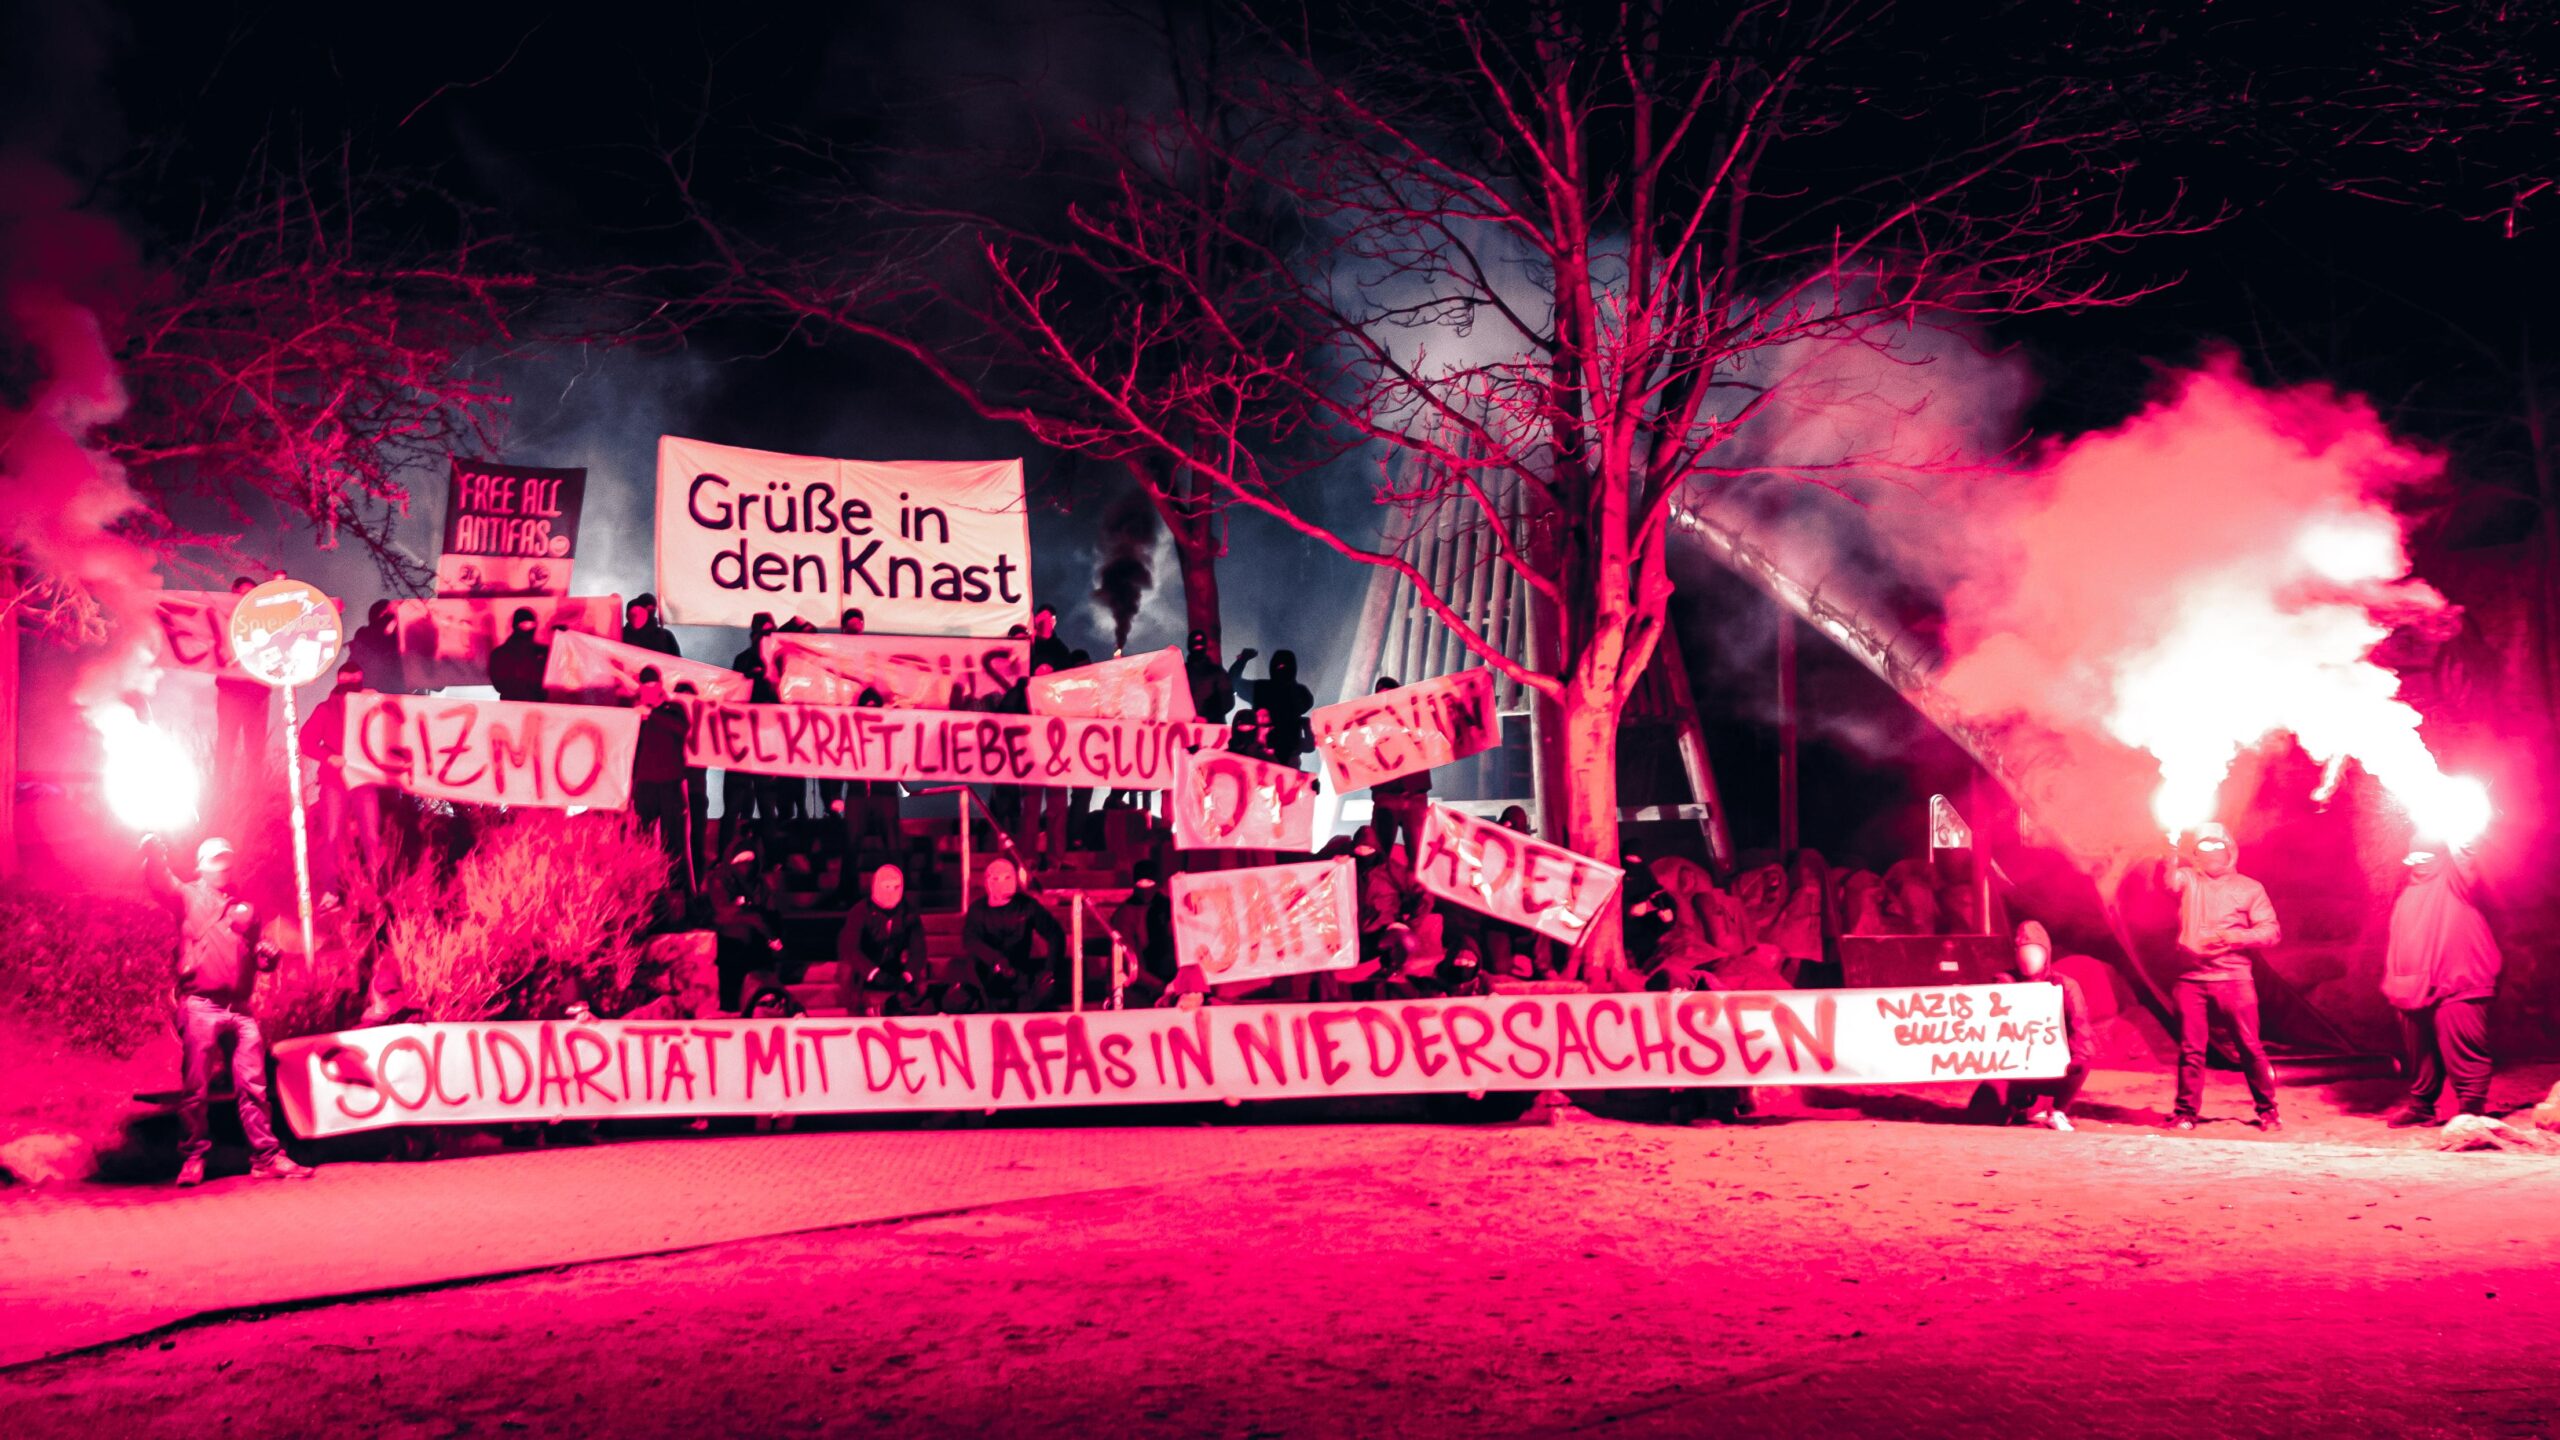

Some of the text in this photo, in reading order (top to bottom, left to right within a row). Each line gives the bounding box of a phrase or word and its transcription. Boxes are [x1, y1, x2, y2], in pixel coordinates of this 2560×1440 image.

[457, 472, 564, 518] FREE ALL
[687, 472, 950, 544] Grüße in
[454, 514, 552, 557] ANTIFAS
[710, 536, 1024, 604] den Knast
[360, 700, 604, 800] GIZMO
[914, 718, 1034, 779] LIEBE
[1045, 716, 1072, 778] &
[1894, 1020, 1987, 1047] BULLEN
[1989, 991, 2013, 1017] &
[320, 1020, 734, 1120] SOLIDARITÄT
[743, 1026, 853, 1099] MIT
[856, 1018, 977, 1095] DEN
[1150, 1008, 1216, 1090] IN
[1233, 992, 1837, 1087] NIEDERSACHSEN
